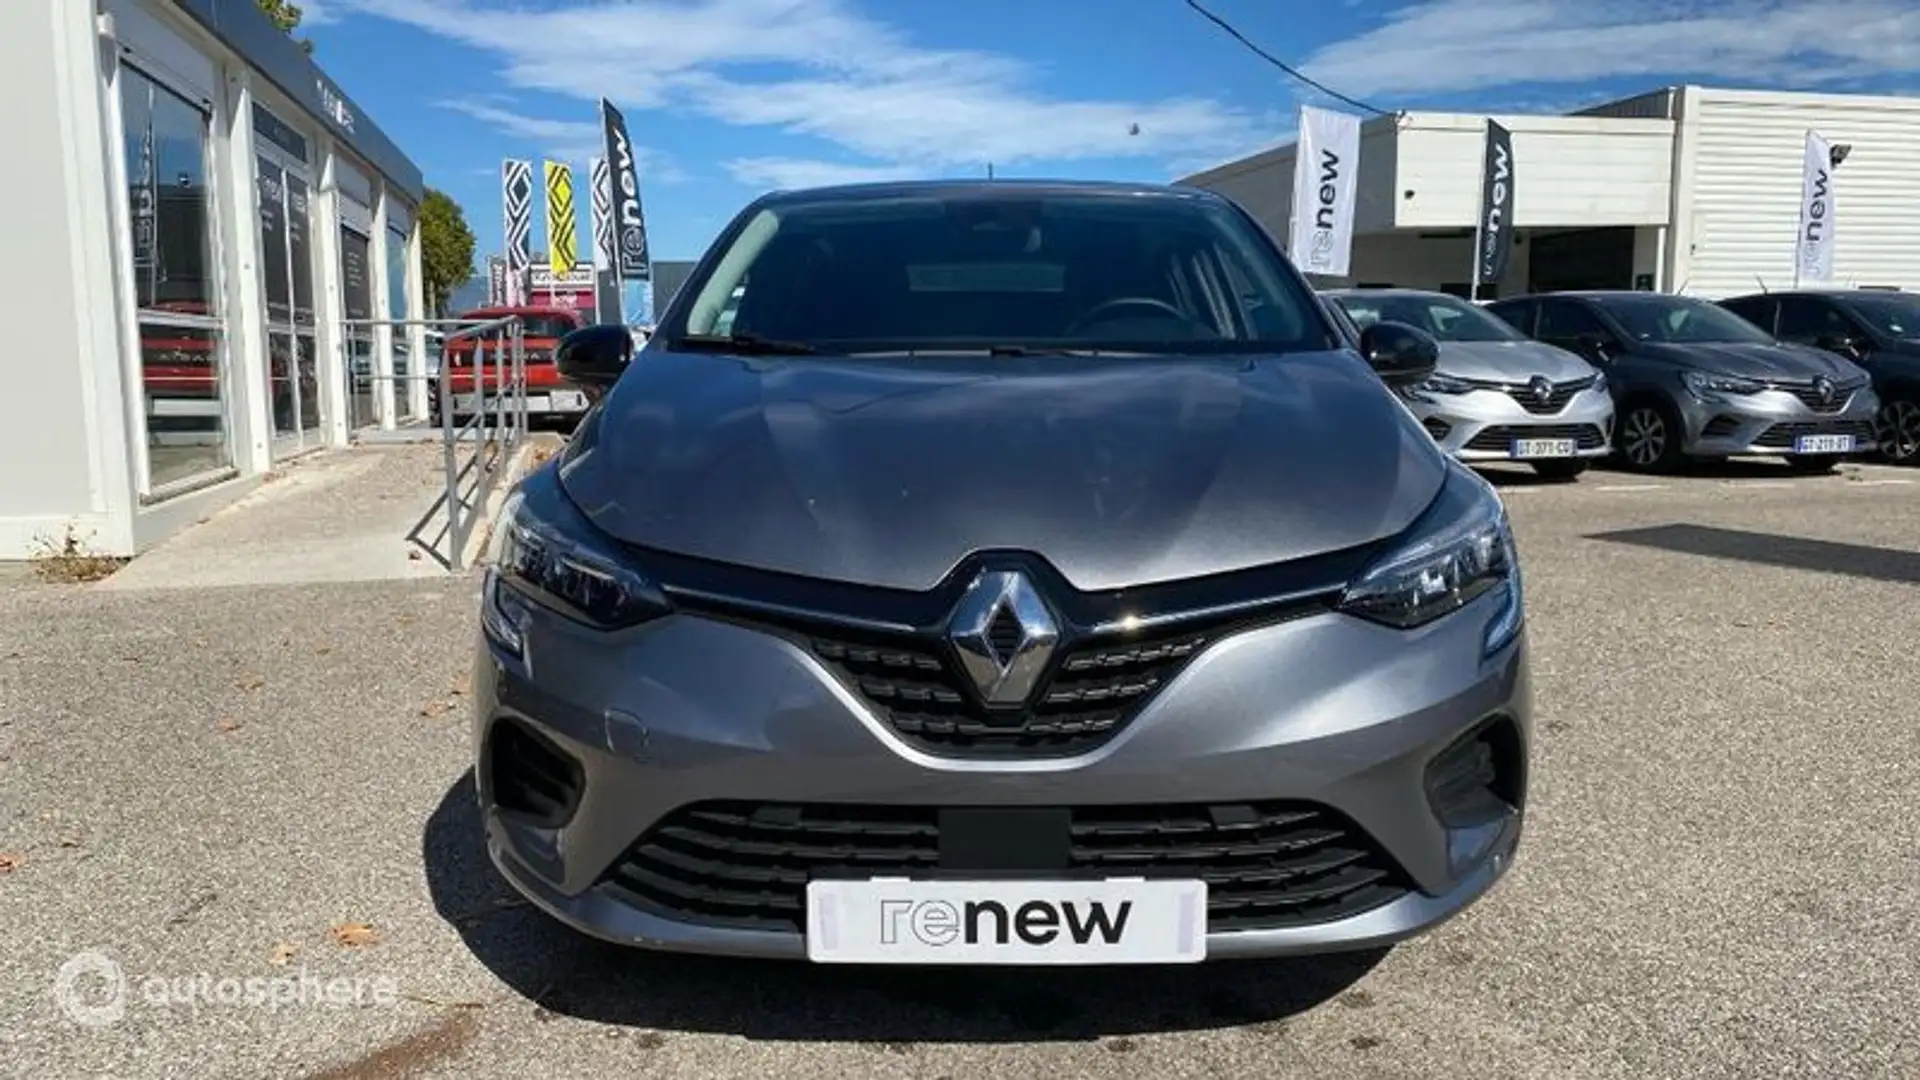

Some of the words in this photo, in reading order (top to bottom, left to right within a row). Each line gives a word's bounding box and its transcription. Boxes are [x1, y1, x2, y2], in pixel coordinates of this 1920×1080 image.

[612, 126, 651, 274] renew
[1310, 148, 1340, 266] renew
[879, 898, 1133, 947] renew
